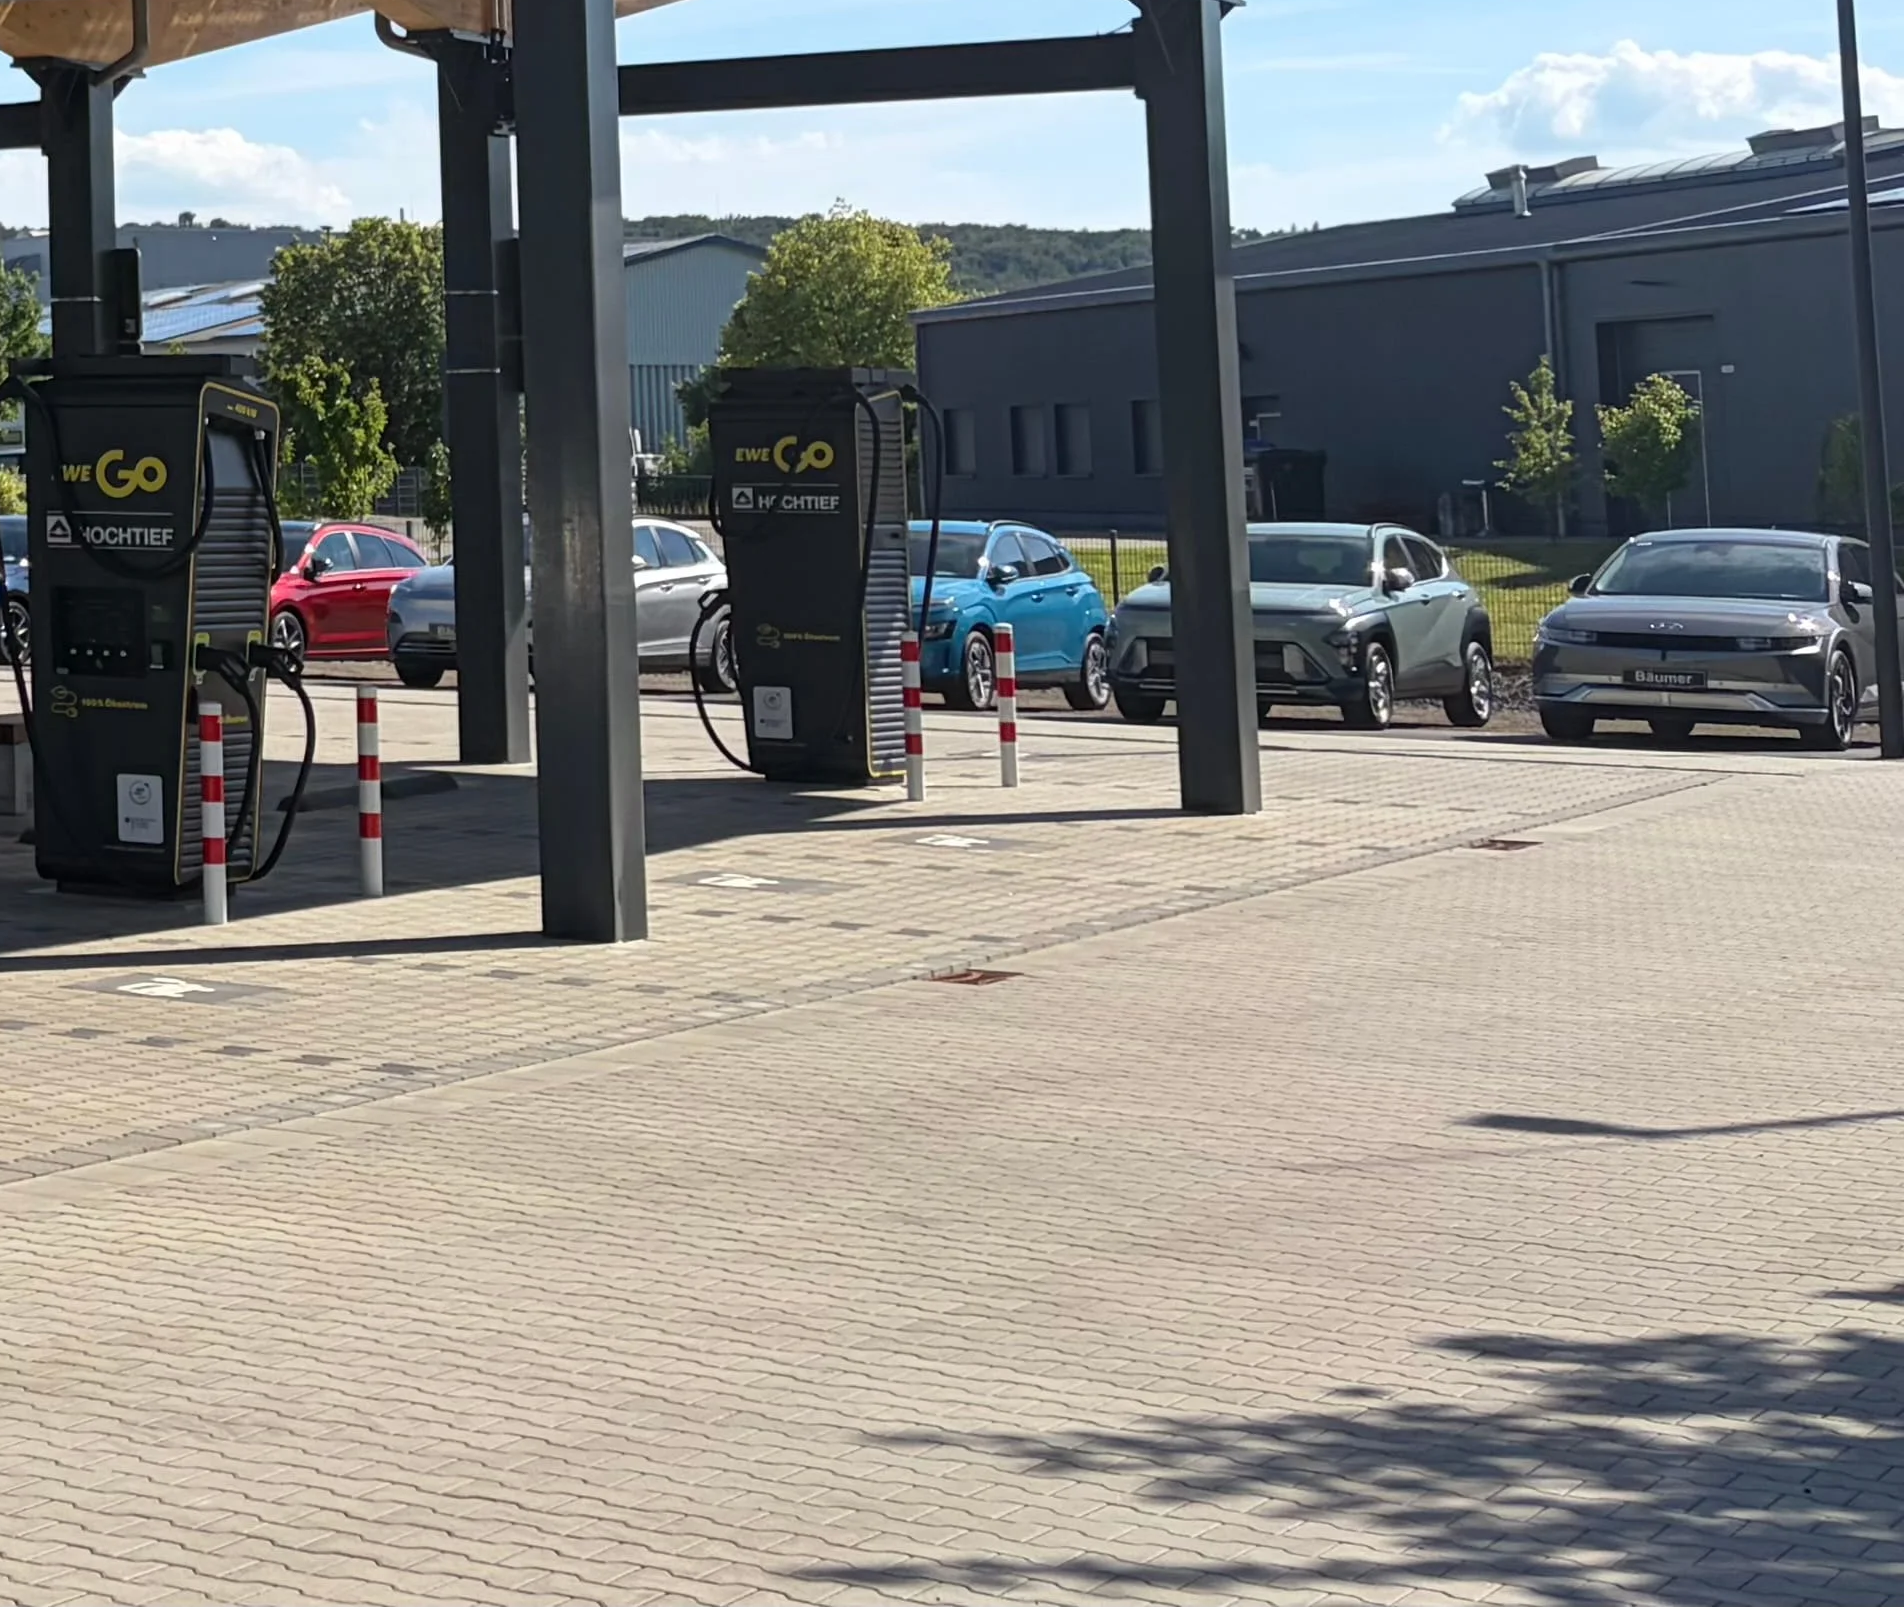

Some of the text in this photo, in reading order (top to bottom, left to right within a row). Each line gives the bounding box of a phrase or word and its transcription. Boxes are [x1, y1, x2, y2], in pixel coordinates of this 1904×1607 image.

[735, 447, 771, 462] EWE
[758, 495, 840, 510] HCHTIEF
[1635, 670, 1693, 684] Bäumer
